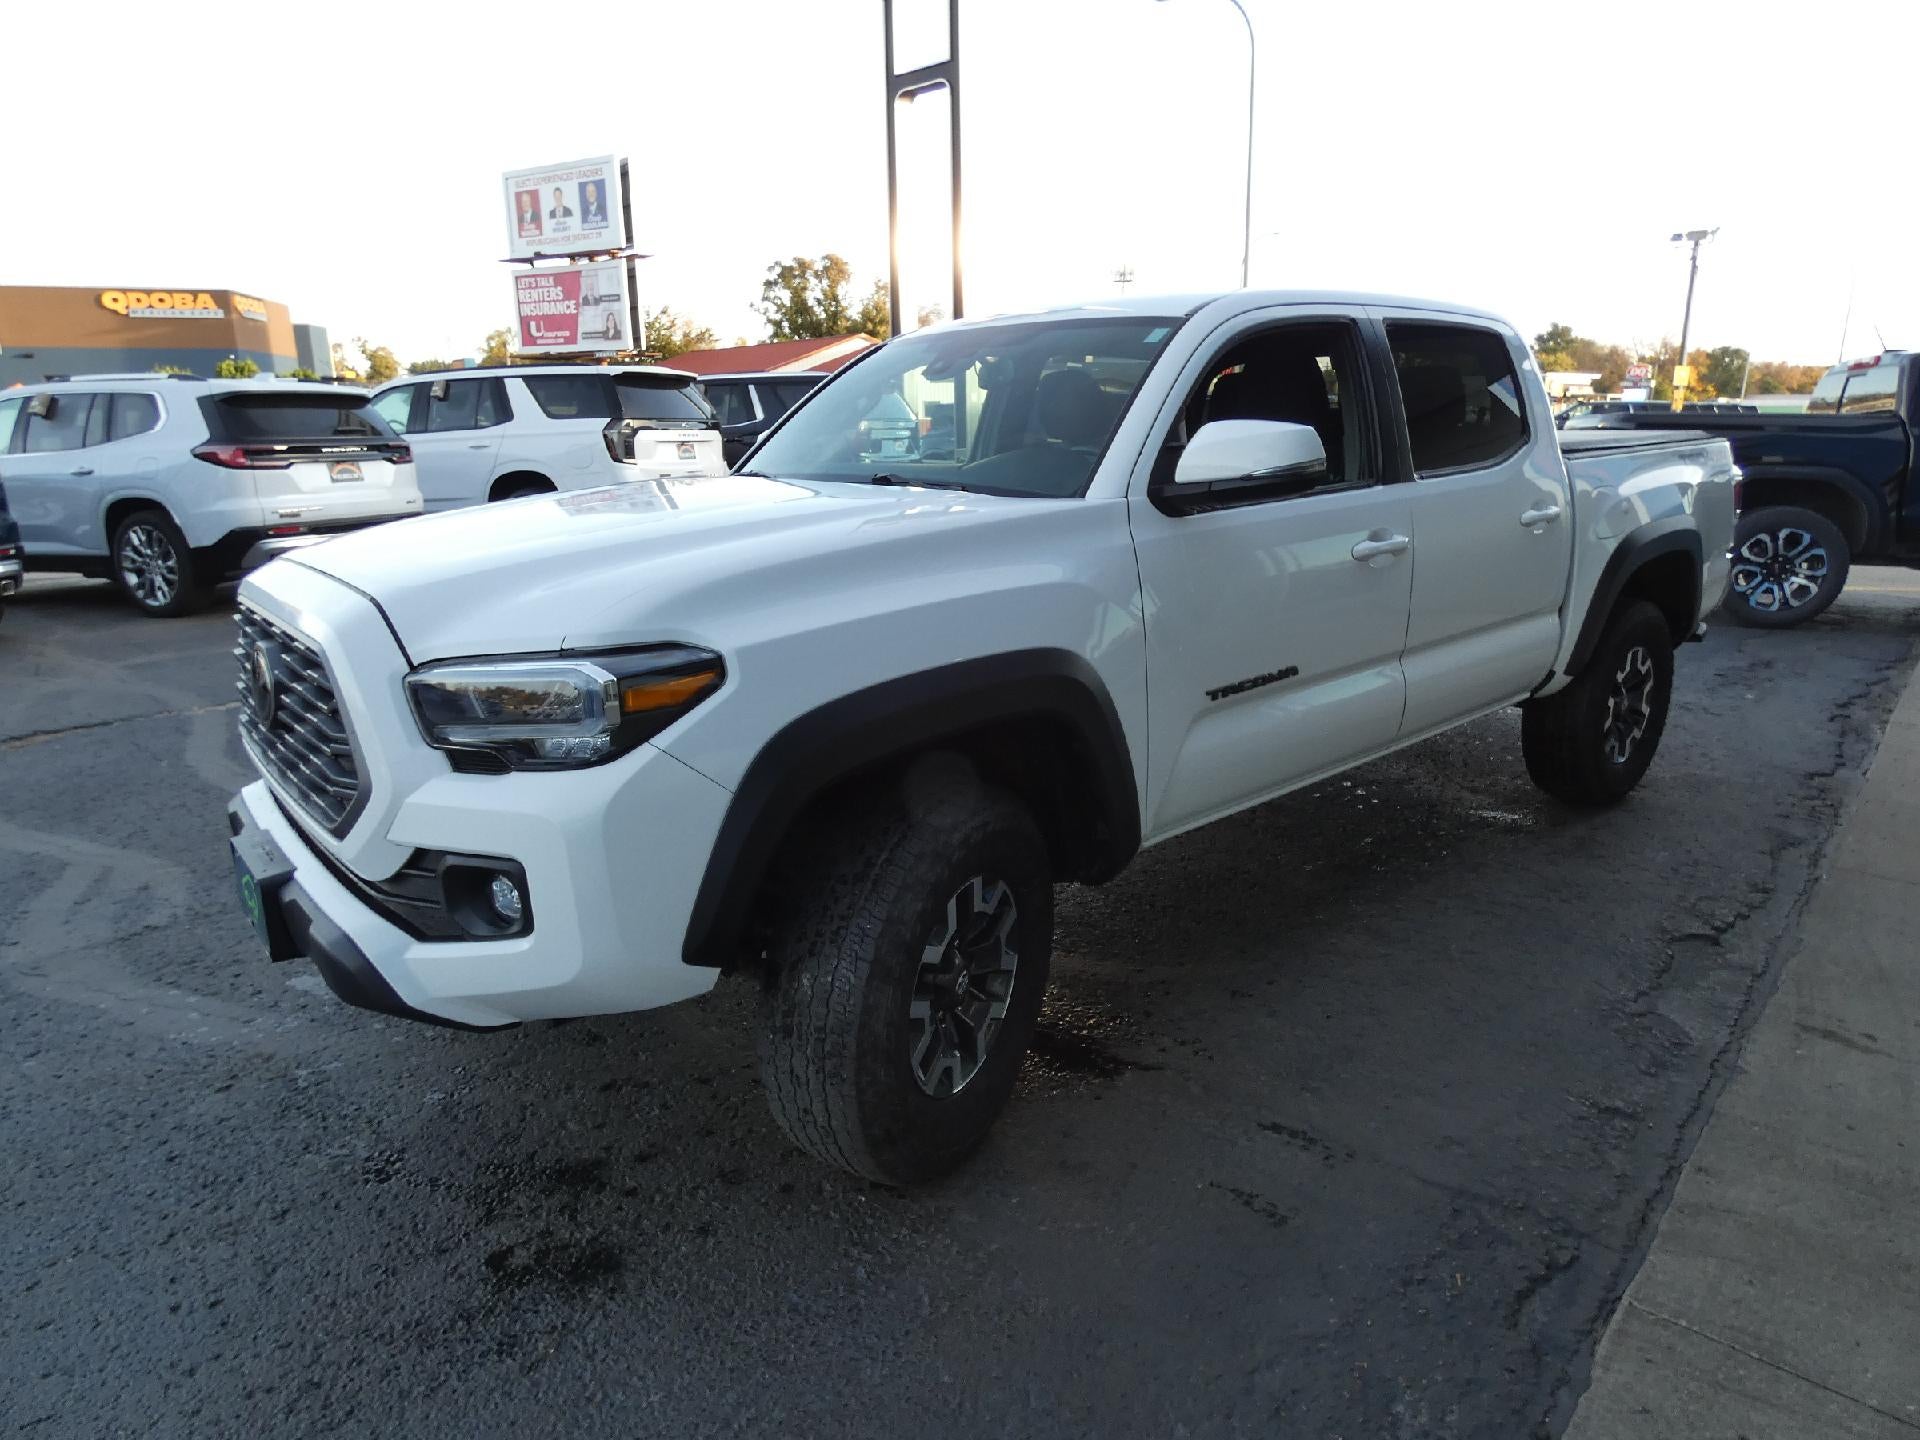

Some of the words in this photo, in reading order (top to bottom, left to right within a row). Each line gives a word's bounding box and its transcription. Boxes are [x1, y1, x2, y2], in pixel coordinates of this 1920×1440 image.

[576, 167, 603, 179] LEADERS
[518, 278, 536, 288] LET'S
[538, 277, 554, 286] TALK
[518, 286, 563, 302] RENTERS
[101, 290, 217, 315] QDOBA
[520, 300, 578, 317] INSURANCE
[1206, 665, 1299, 701] TACOMA
